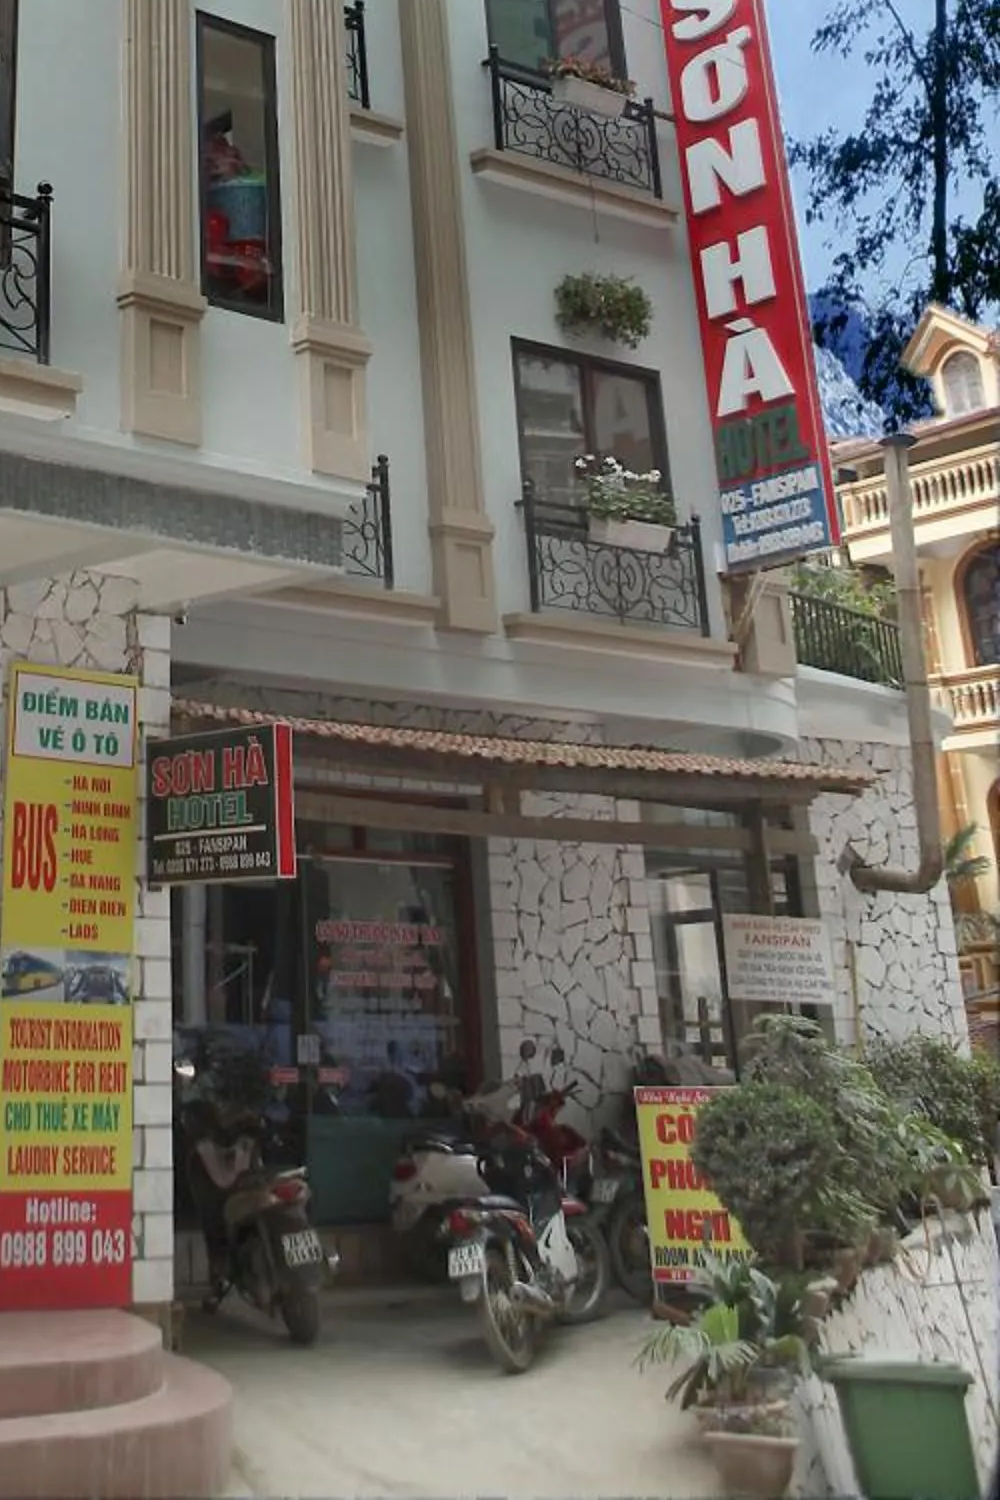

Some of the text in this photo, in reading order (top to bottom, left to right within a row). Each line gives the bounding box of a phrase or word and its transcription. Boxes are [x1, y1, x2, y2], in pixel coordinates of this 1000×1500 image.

[700, 223, 796, 418] HÀ
[717, 402, 810, 482] HOTEL
[85, 697, 129, 725] BÁN
[38, 725, 120, 757] VÉ Ô TÔ
[152, 735, 269, 797] SƠN HÀ
[168, 790, 253, 831] HOTEL
[11, 800, 58, 893] BUS
[74, 1059, 95, 1094] FOR
[99, 1060, 127, 1094] RENT
[5, 1101, 31, 1132] CHO
[72, 1102, 89, 1132] XE
[62, 1145, 116, 1176] SERVICE
[26, 1198, 97, 1226] Hotline:
[0, 1229, 125, 1268] 0988 899 043
